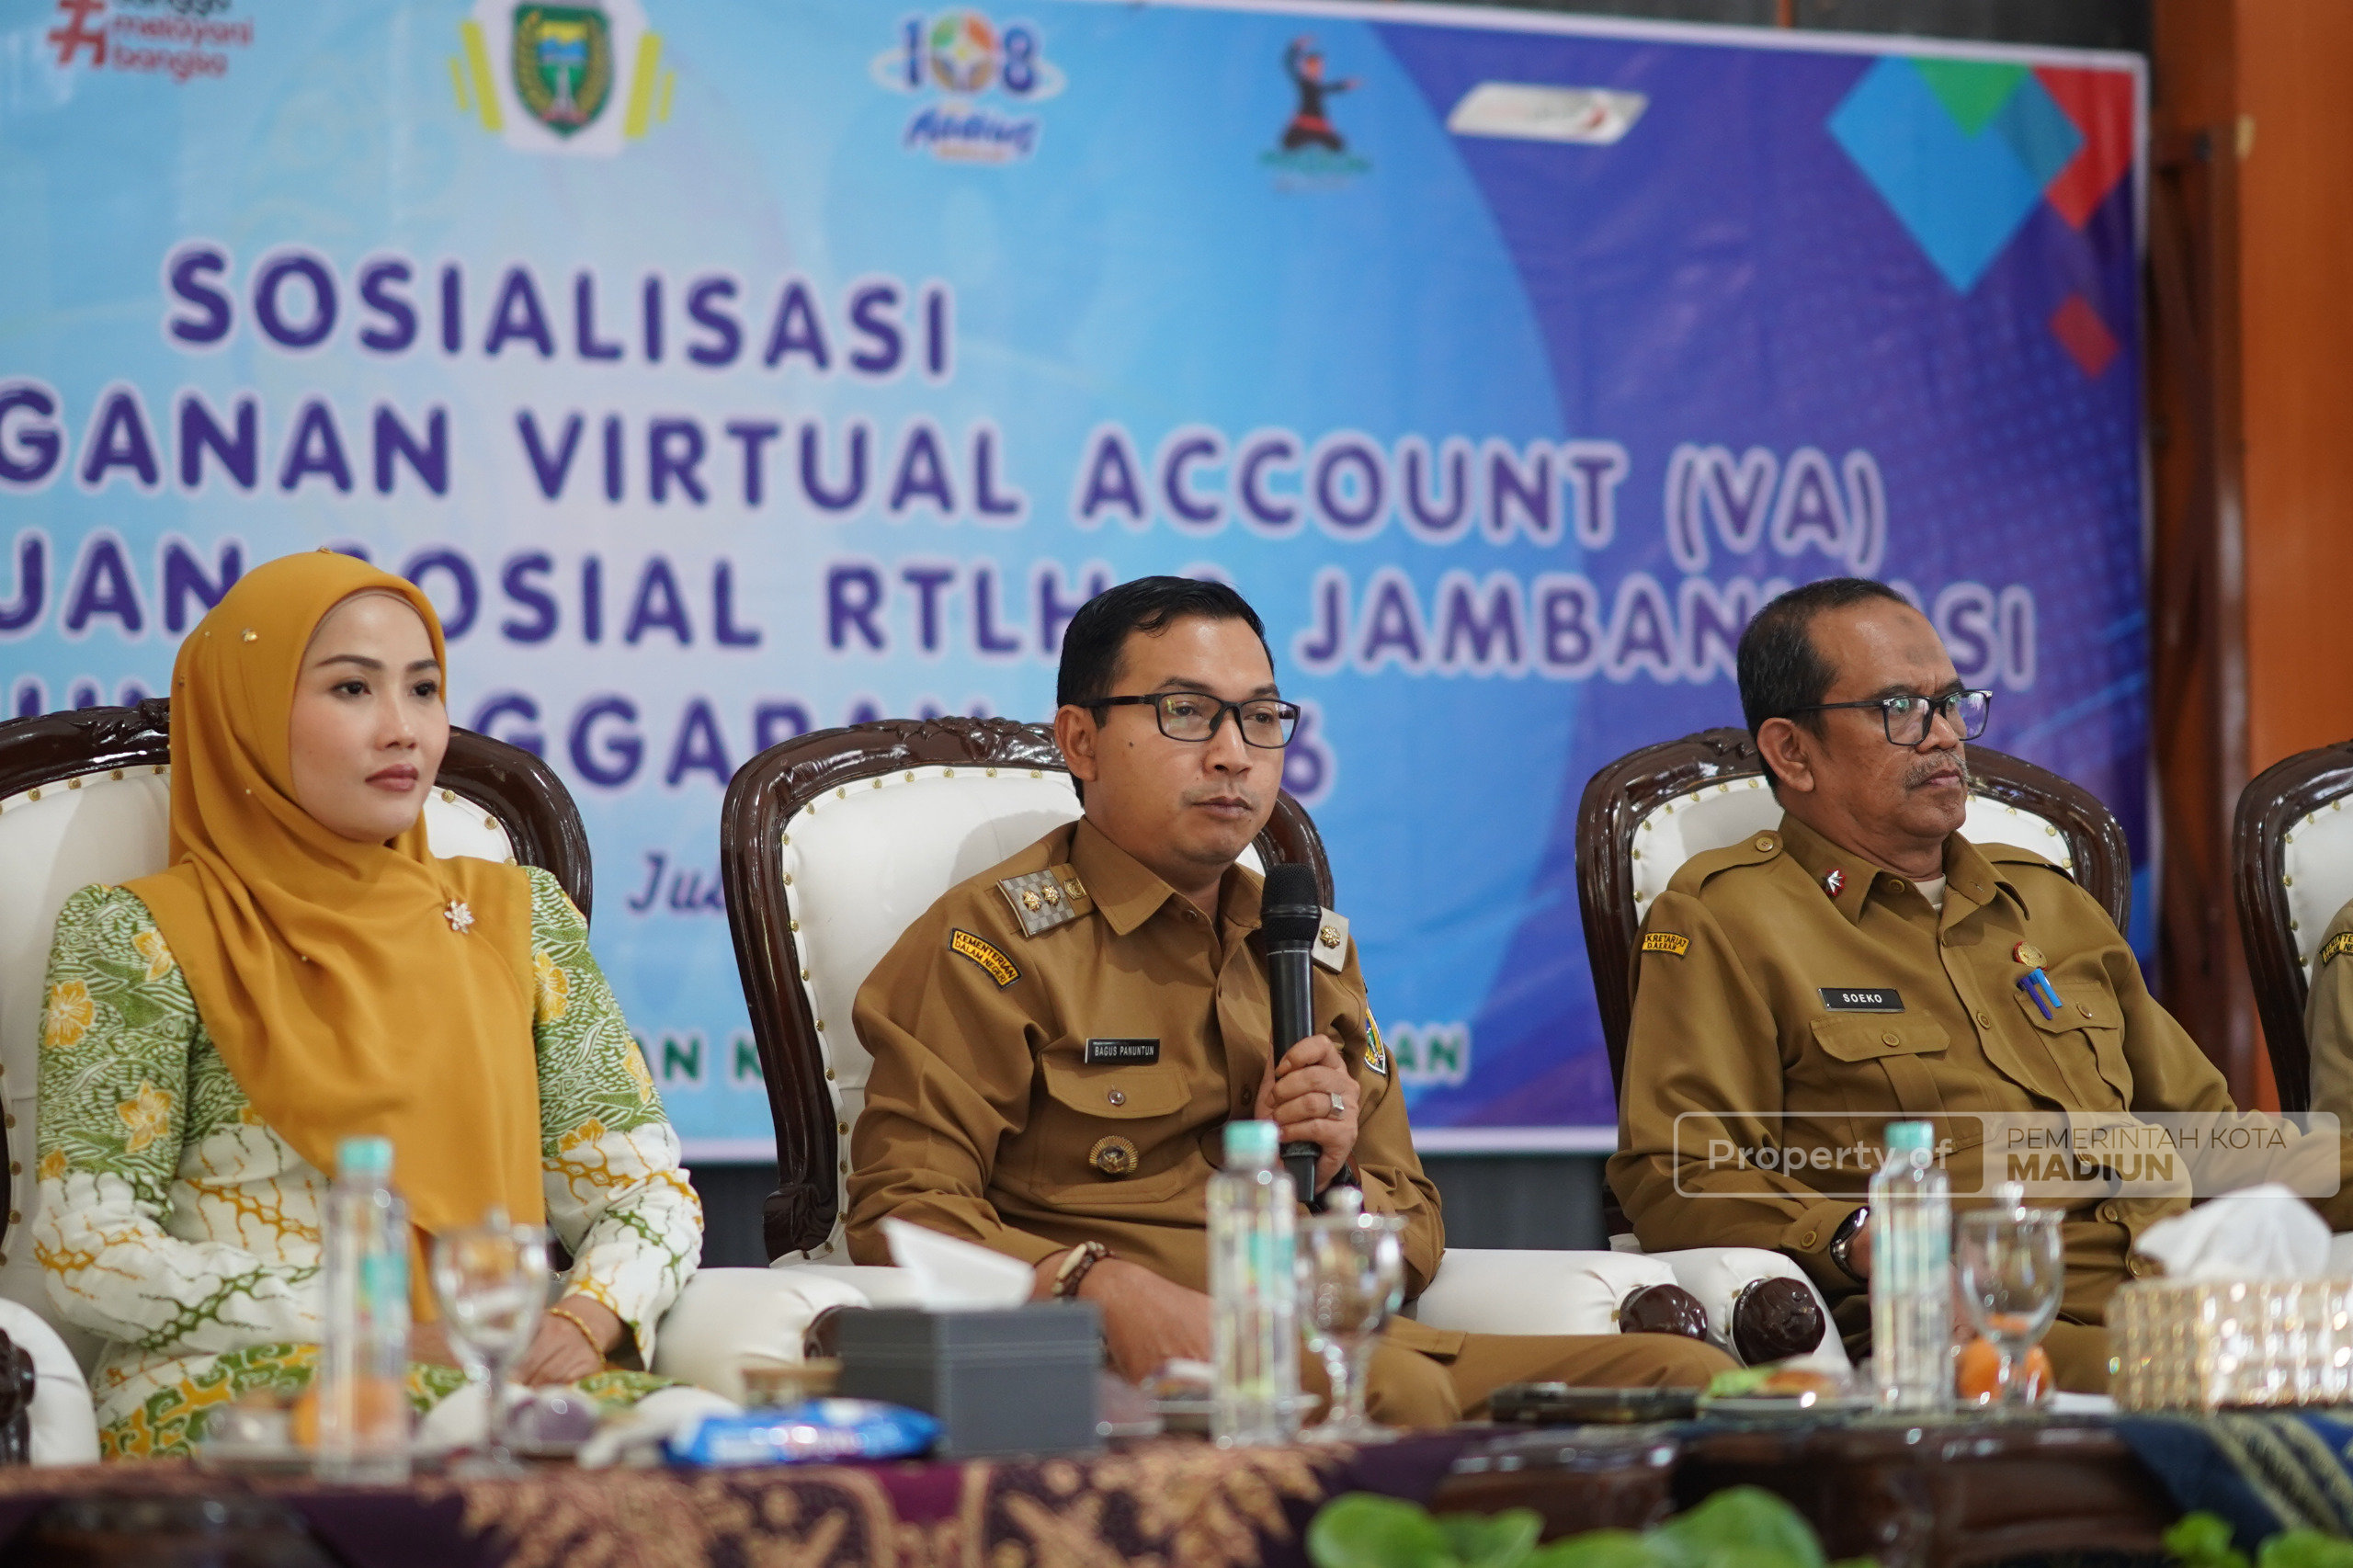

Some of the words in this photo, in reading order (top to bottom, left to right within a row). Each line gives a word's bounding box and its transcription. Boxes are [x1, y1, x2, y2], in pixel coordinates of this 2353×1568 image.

[169, 249, 945, 375] SOSIALISASI
[517, 408, 1021, 517] VIRTUAL
[1079, 432, 1618, 533] ACCOUNT
[1677, 454, 1878, 568] (VA)
[331, 544, 762, 648] OSIAL
[954, 940, 983, 961] DALAM
[983, 958, 1007, 983] NEGERI
[956, 931, 1017, 978] KEMENTERIAN
[1842, 993, 1882, 1004] SOEKO
[1094, 1045, 1118, 1057] BAGUS
[1119, 1045, 1154, 1056] PANUNTUN
